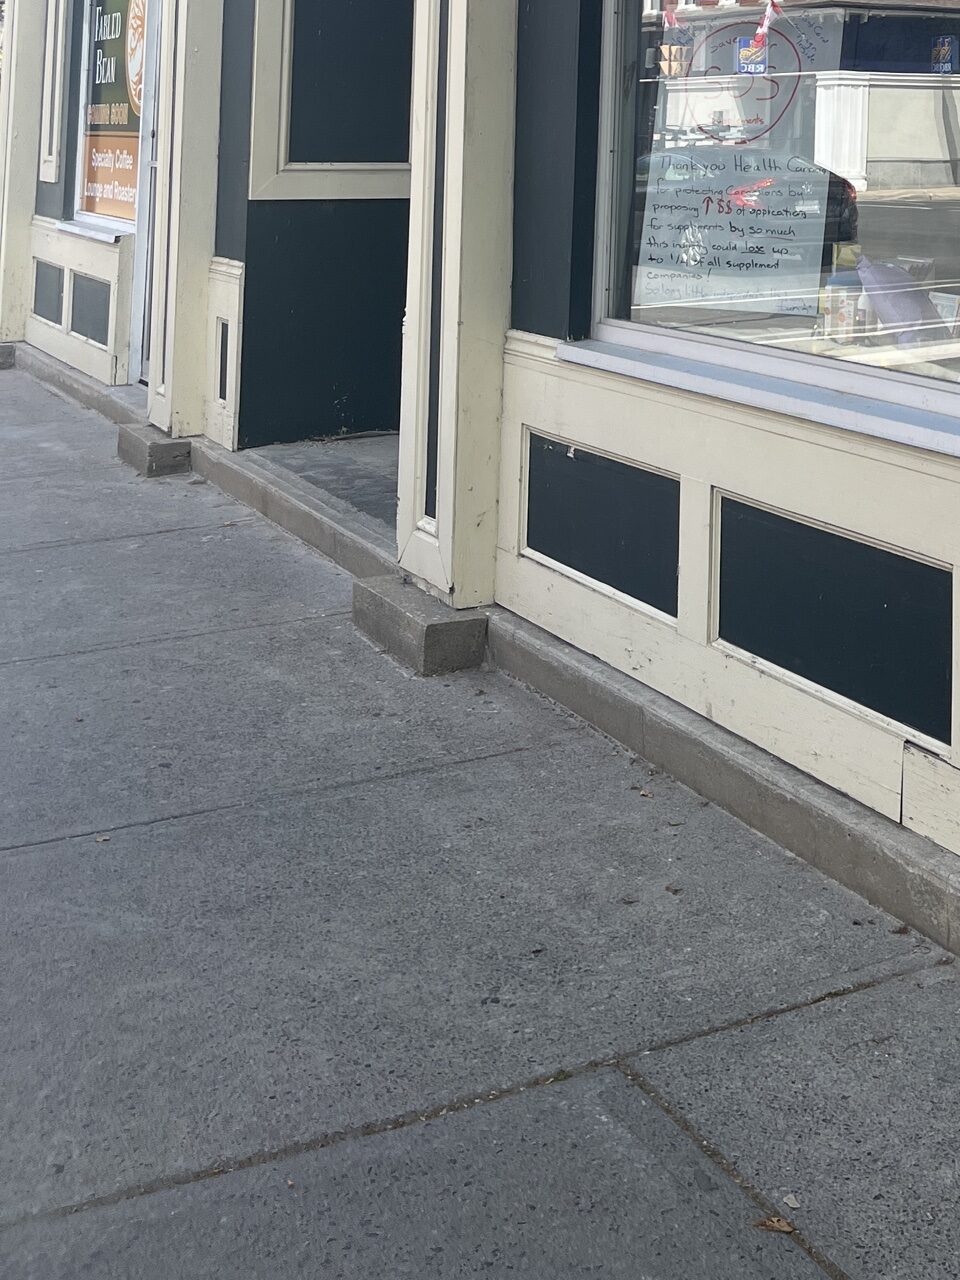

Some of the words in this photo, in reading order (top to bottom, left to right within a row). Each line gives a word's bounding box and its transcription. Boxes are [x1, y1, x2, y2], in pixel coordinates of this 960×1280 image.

[92, 148, 115, 172] Specialty
[115, 149, 133, 170] Coffee
[660, 155, 697, 171] Thank
[701, 163, 726, 177] you
[734, 155, 781, 173] Health
[84, 178, 103, 202] Lounge
[103, 180, 113, 199] and
[789, 184, 804, 205] by
[652, 203, 699, 217] proposing
[736, 205, 745, 216] of
[646, 218, 664, 231] for
[729, 219, 745, 237] by
[765, 227, 796, 236] much
[646, 237, 668, 248] this
[711, 242, 738, 252] could
[772, 247, 789, 259] up
[648, 255, 663, 264] to
[706, 257, 721, 267] all
[726, 260, 779, 271] supplement
